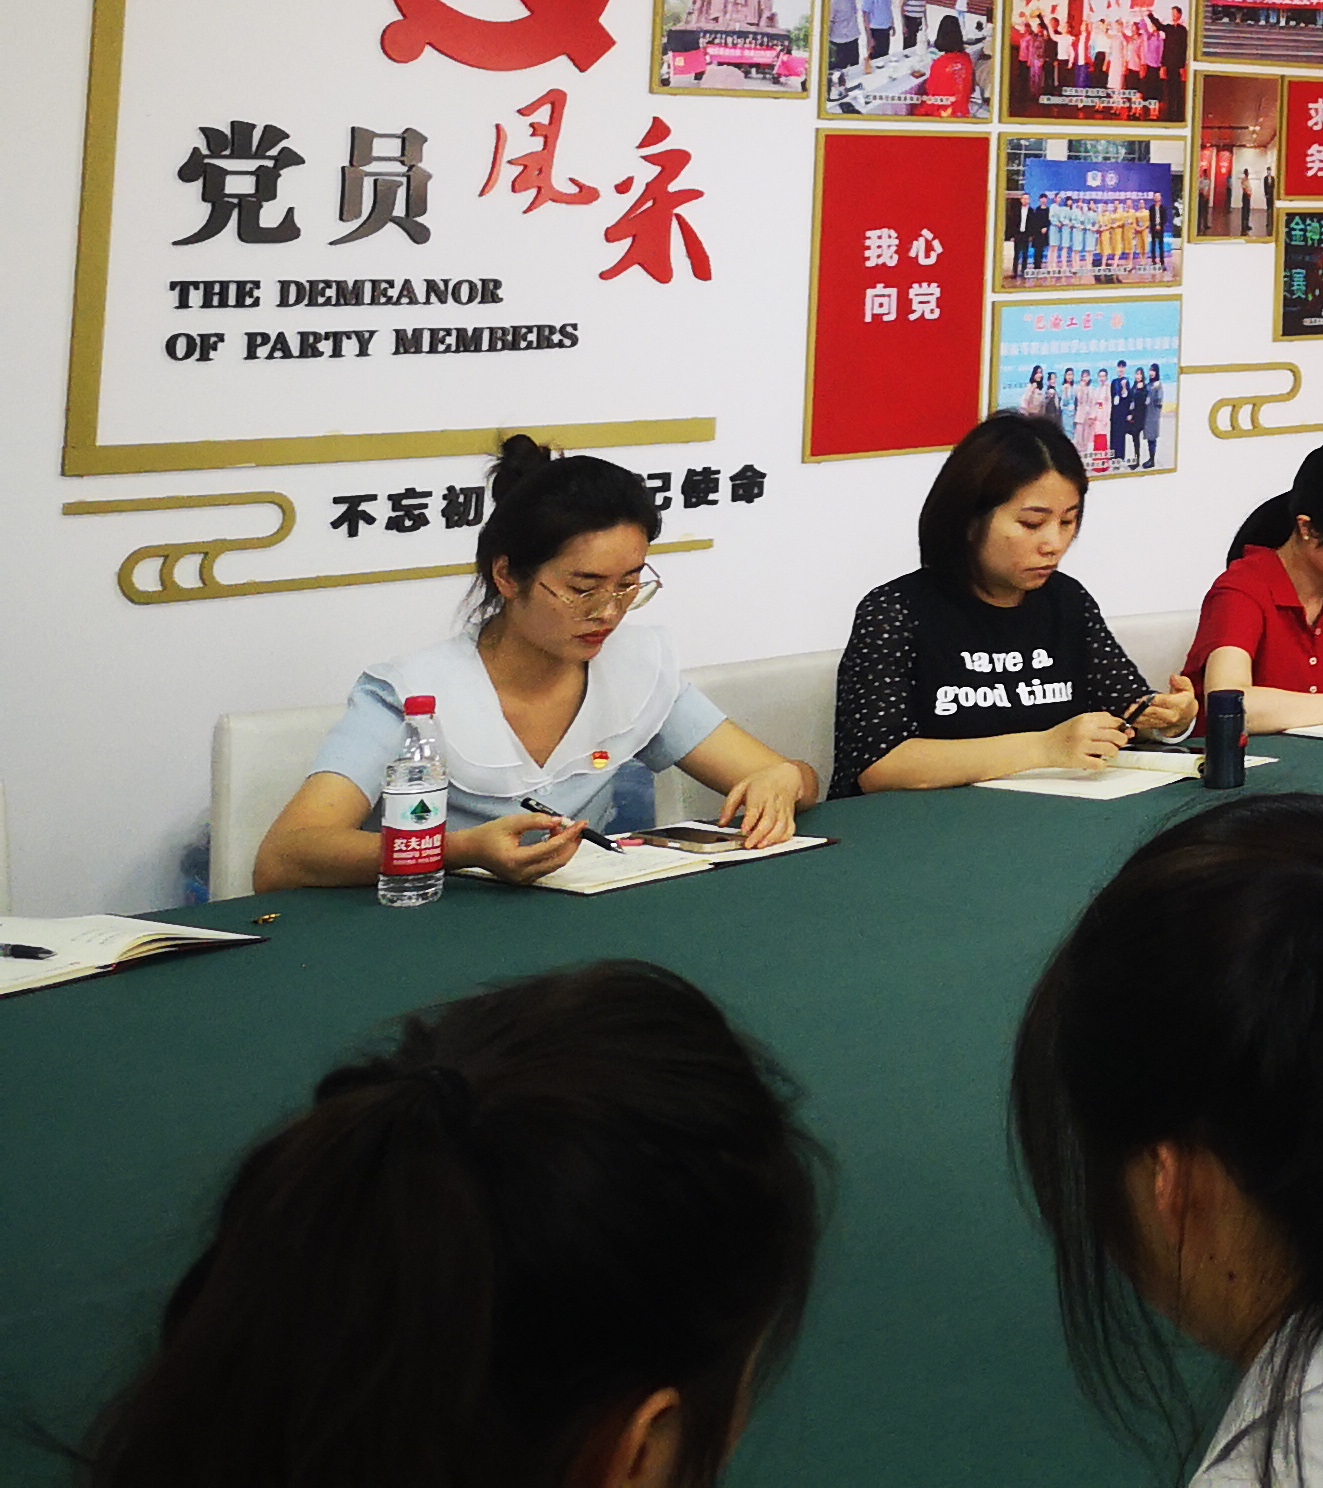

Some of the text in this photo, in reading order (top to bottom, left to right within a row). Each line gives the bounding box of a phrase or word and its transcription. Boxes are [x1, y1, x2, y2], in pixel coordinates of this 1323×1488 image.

[864, 227, 944, 268] 我心
[170, 277, 504, 310] THE DEMEANOR
[864, 281, 942, 323] 向党
[165, 322, 580, 361] OF PARTY MEMBERS
[330, 464, 768, 538] 不忘初 记使命
[1031, 649, 1053, 669] a
[935, 683, 1012, 716] good
